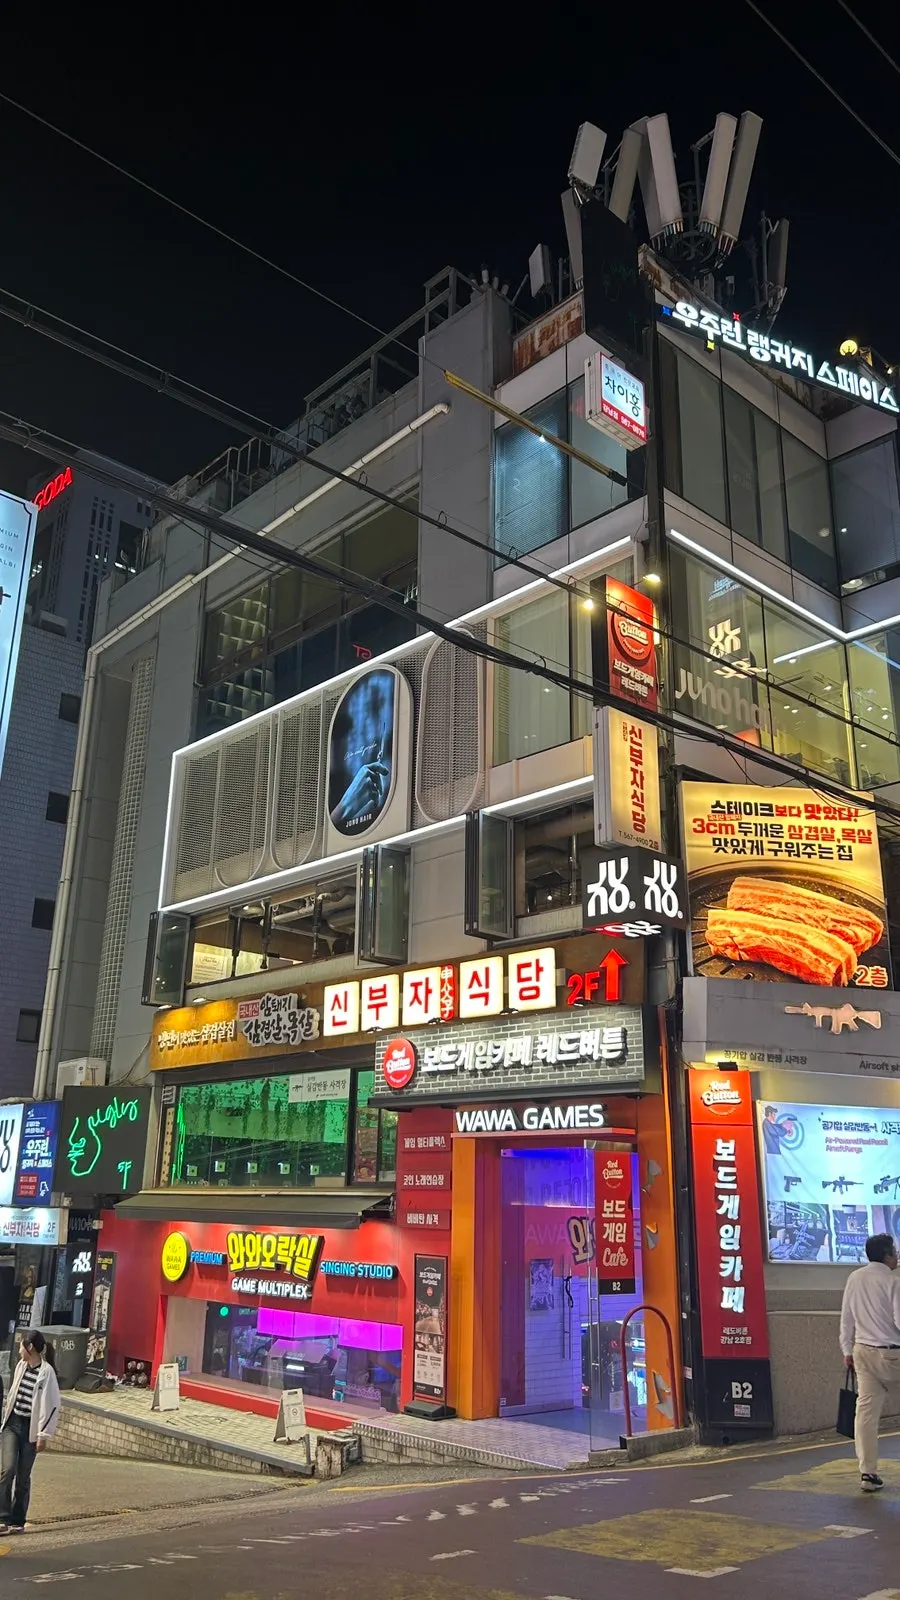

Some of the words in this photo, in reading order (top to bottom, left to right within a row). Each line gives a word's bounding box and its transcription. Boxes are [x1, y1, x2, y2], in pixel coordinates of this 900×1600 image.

[672, 300, 746, 350] 우주런
[747, 329, 814, 378] 랭귀지
[817, 361, 900, 413] 스페이스
[629, 725, 646, 834] 신부자식당
[692, 818, 735, 836] 3cm
[738, 821, 784, 839] 두꺼운
[712, 837, 764, 856] 맛있게
[767, 840, 833, 860] 구워주는
[836, 844, 853, 861] 집
[856, 966, 888, 988] 2층
[567, 971, 600, 1005] 2F
[260, 994, 293, 1017] 암돼지
[421, 1035, 533, 1072] 보드게임카페
[537, 1027, 627, 1064] 레드버튼
[785, 1053, 808, 1065] 사격장
[859, 1060, 889, 1072] Airsoft
[455, 1109, 517, 1132] WAWA
[523, 1104, 605, 1130] GAMES
[822, 1120, 843, 1131] 공기압
[606, 1160, 619, 1170] Red
[602, 1200, 626, 1219] 보드
[47, 1222, 56, 1233] 2F
[602, 1222, 627, 1244] 게임
[713, 1138, 745, 1314] 보드게임카페
[166, 1256, 182, 1264] WAWA
[190, 1250, 223, 1264] PREMIUM
[228, 1232, 318, 1280] 와와오락실
[602, 1248, 628, 1268] Cafe
[166, 1263, 181, 1272] GAMES
[320, 1261, 356, 1277] SINGING
[356, 1264, 393, 1280] STUDIO
[232, 1277, 256, 1293] GAME
[258, 1280, 308, 1299] MULTIPLEX
[612, 1282, 622, 1292] B2
[732, 1382, 753, 1399] B2
